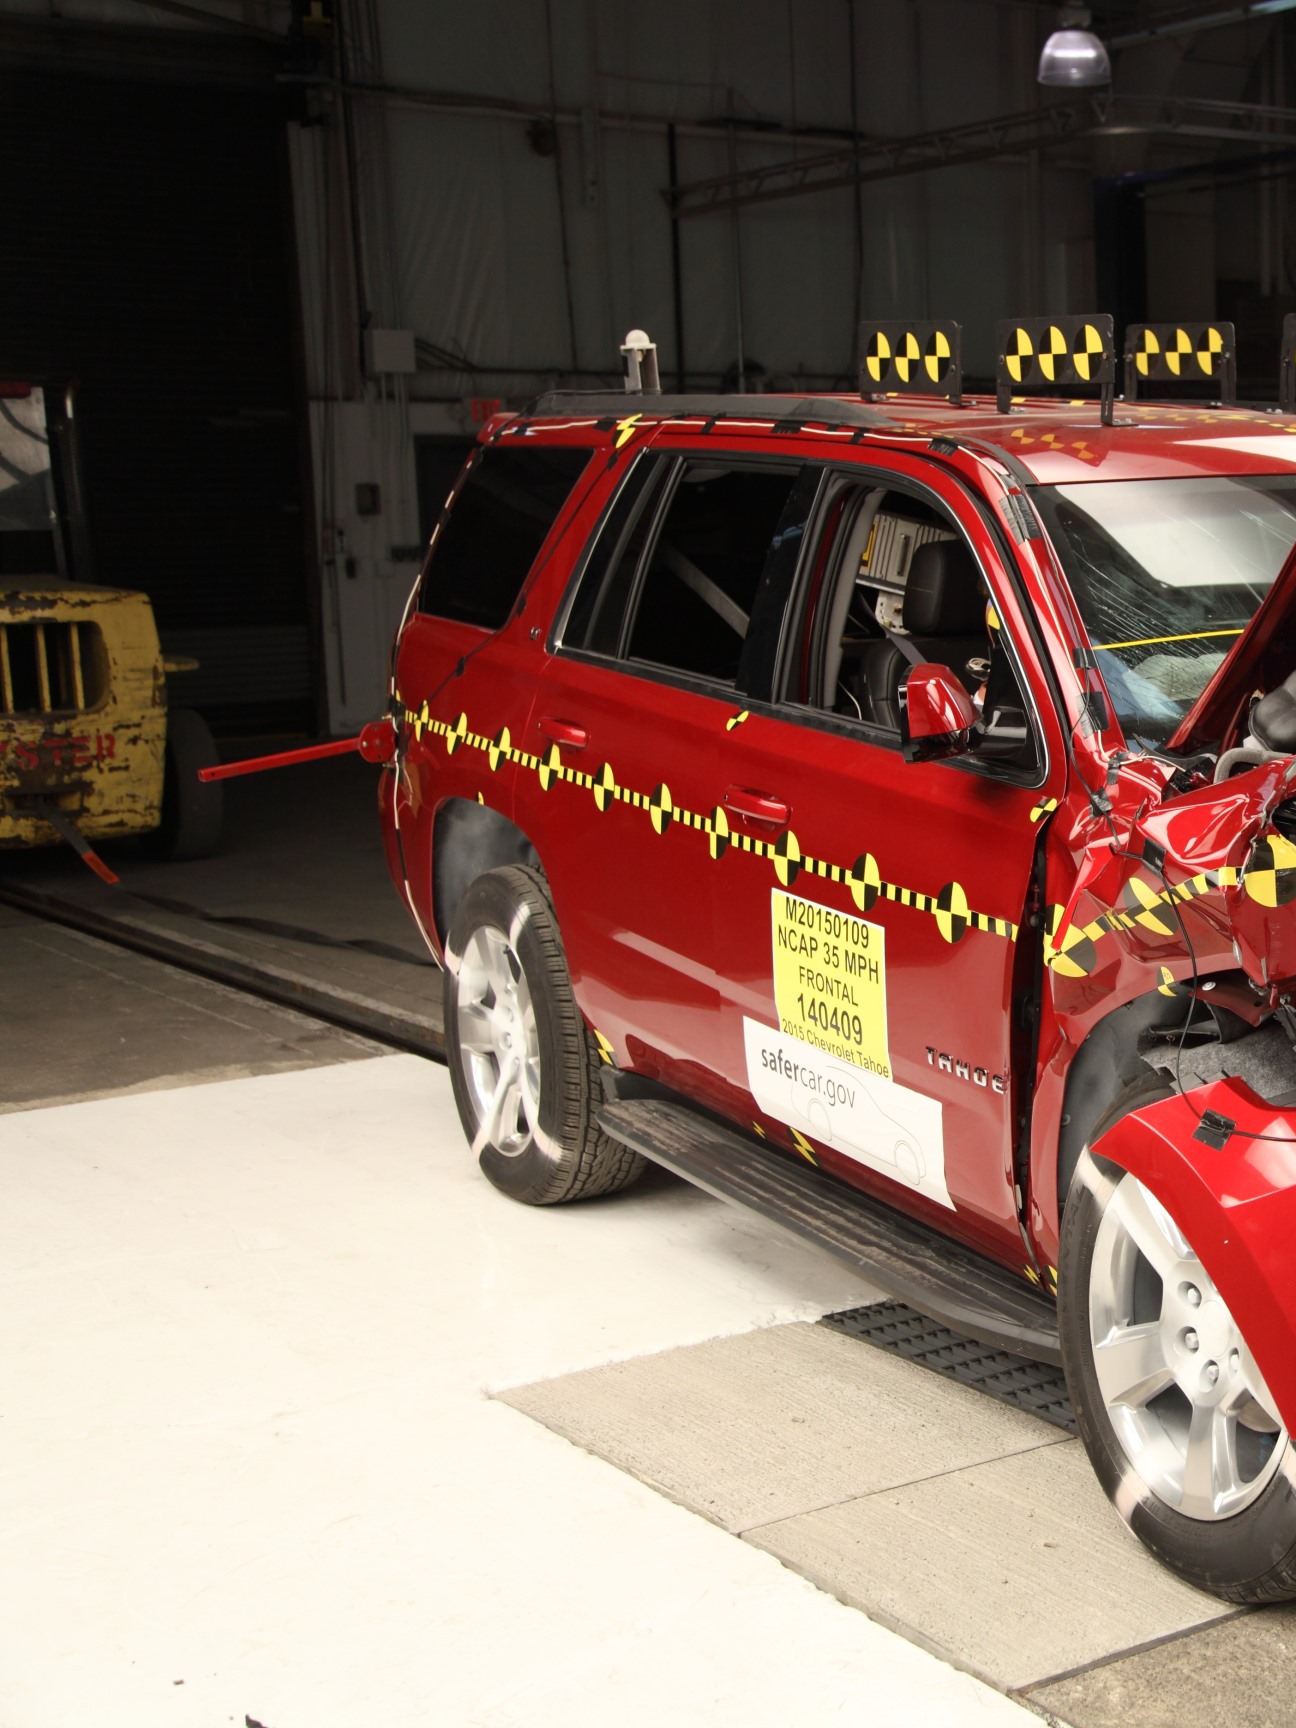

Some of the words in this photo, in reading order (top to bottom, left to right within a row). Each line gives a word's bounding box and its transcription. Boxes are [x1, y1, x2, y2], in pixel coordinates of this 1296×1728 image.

[785, 896, 870, 949] M20150109
[778, 924, 819, 958] NCAP
[823, 942, 840, 968] 35
[844, 949, 880, 985] MPH
[798, 965, 859, 1007] FRONTAL
[797, 992, 863, 1046] 140409
[782, 1017, 805, 1041] 2015
[806, 1030, 855, 1064] Chevrolet
[856, 1051, 889, 1079] Tahoe
[925, 1046, 1011, 1095] TAHOE
[761, 1047, 856, 1109] safercar.gov
